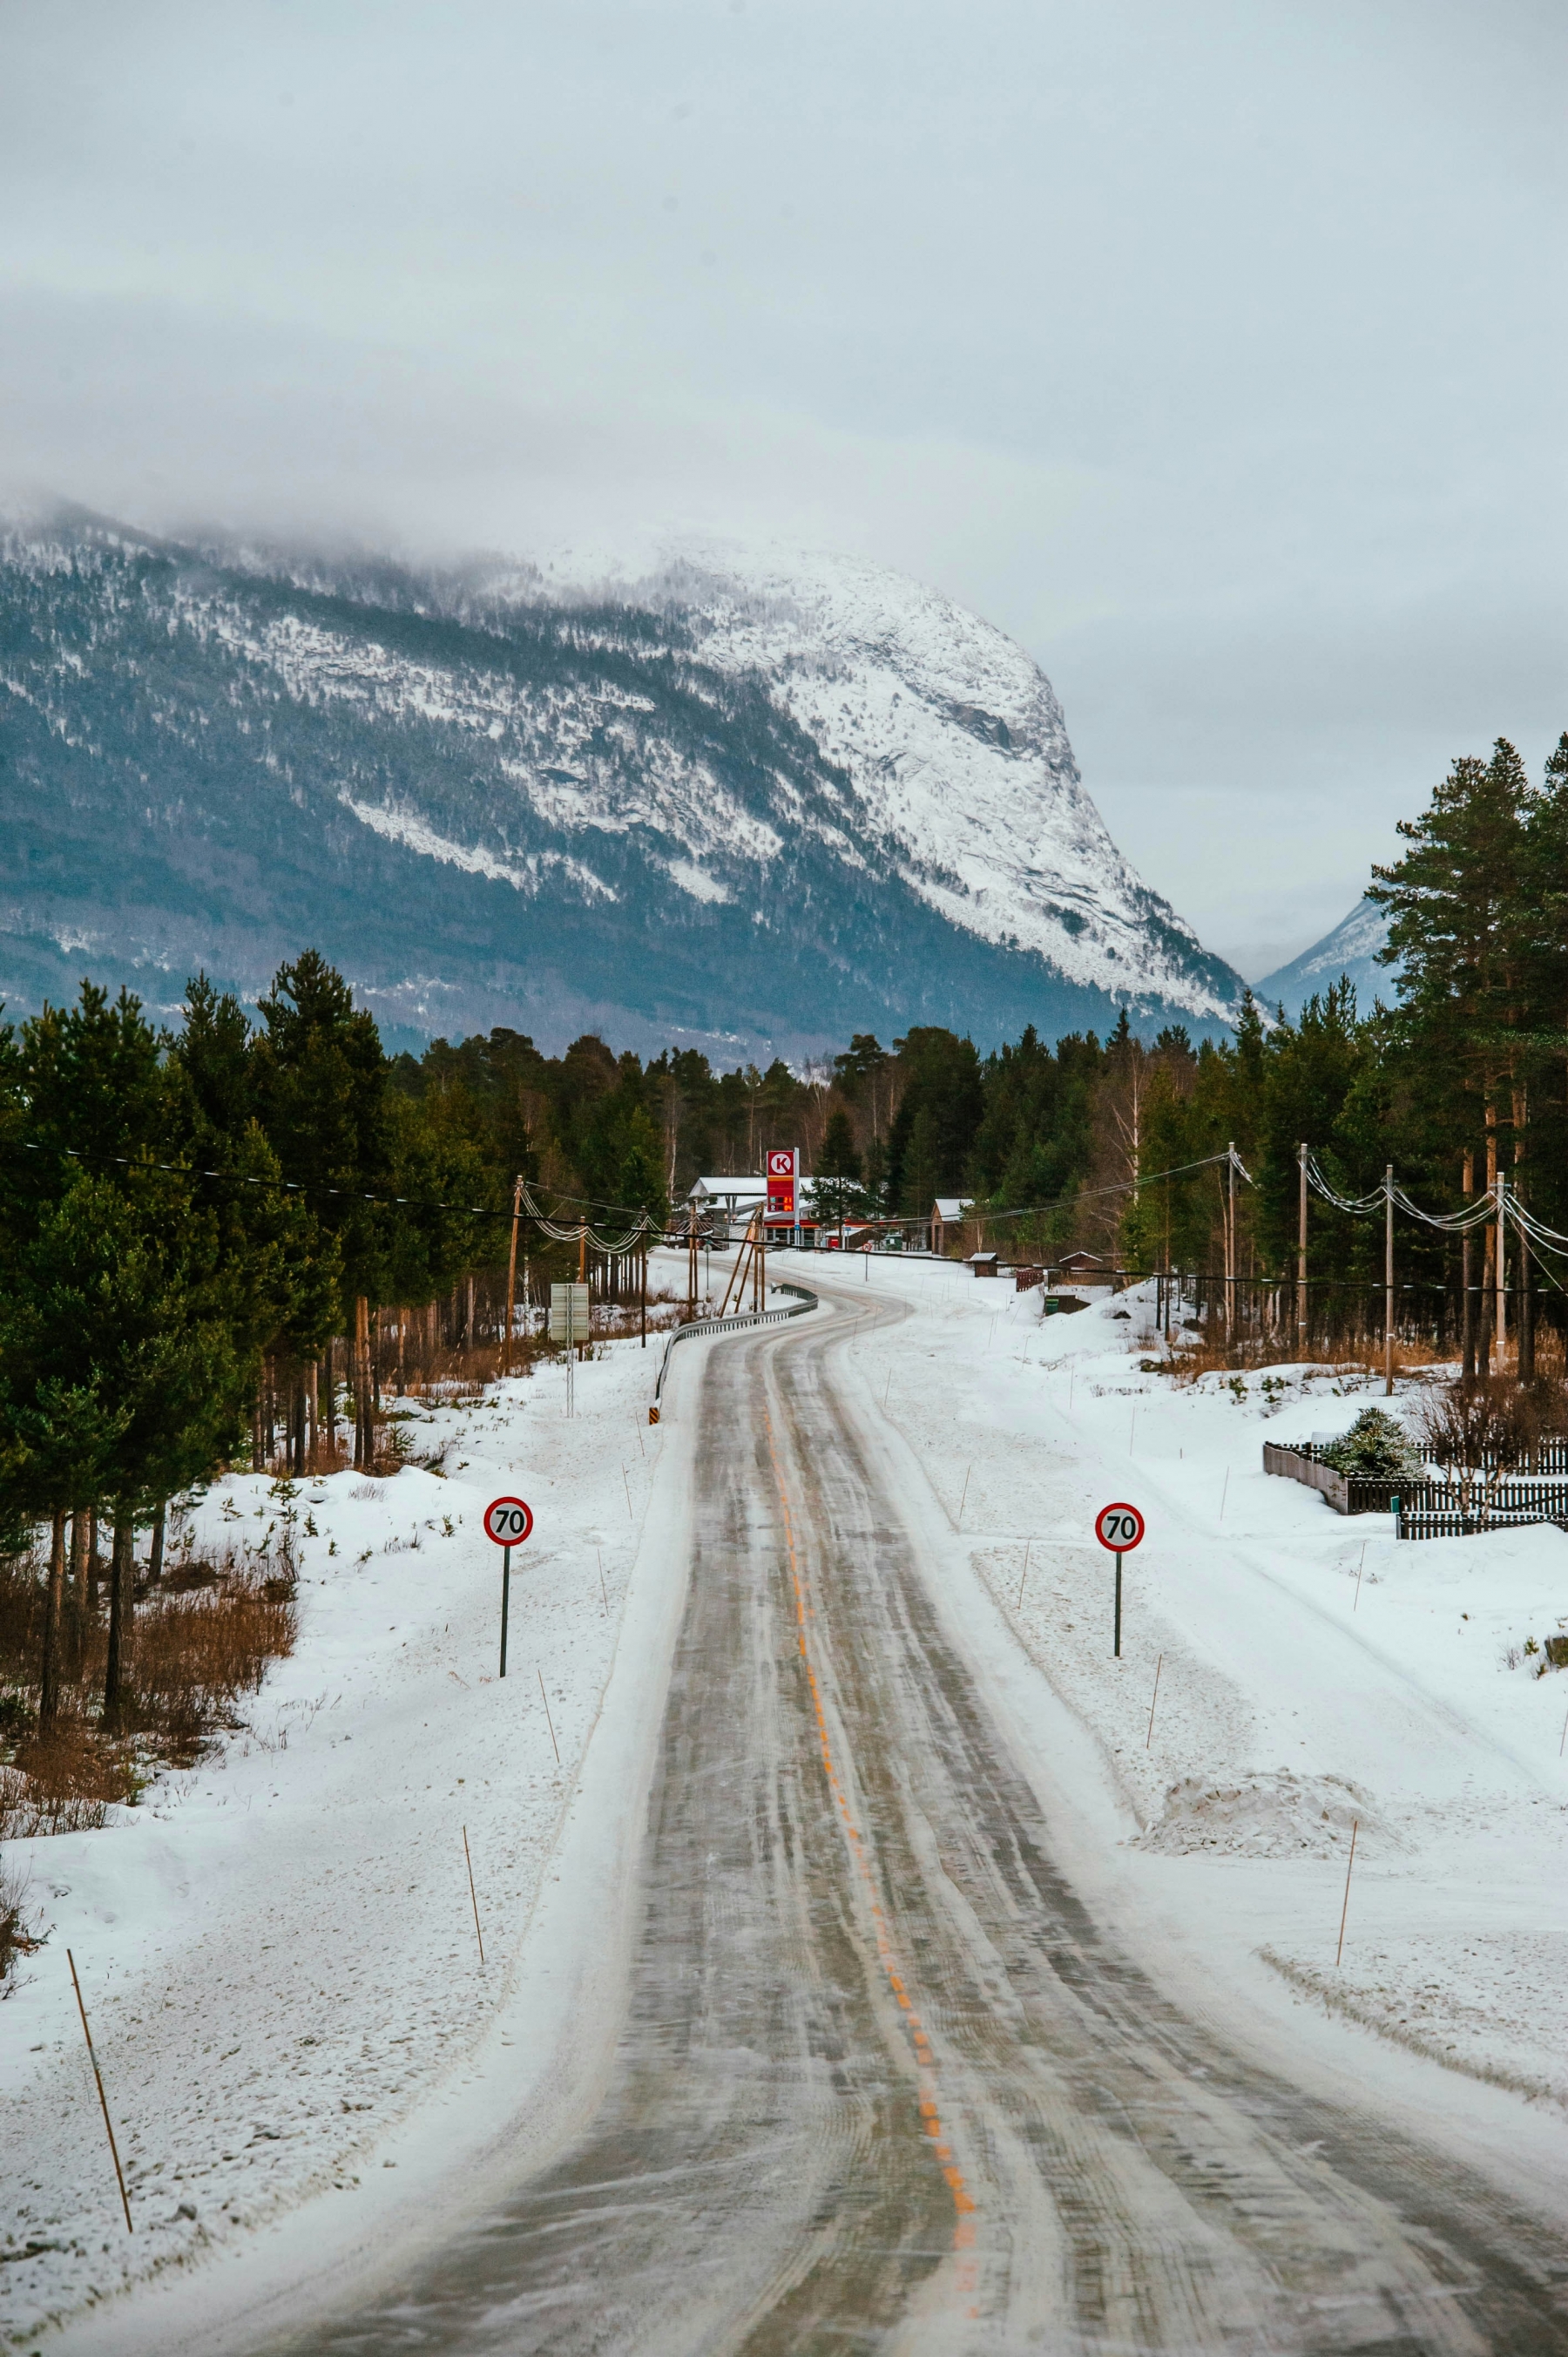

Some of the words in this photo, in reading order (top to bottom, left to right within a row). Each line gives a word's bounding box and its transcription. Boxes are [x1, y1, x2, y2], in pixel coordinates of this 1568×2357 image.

[776, 1157, 789, 1171] K
[496, 1510, 524, 1534] 70
[1107, 1516, 1136, 1540] 70
